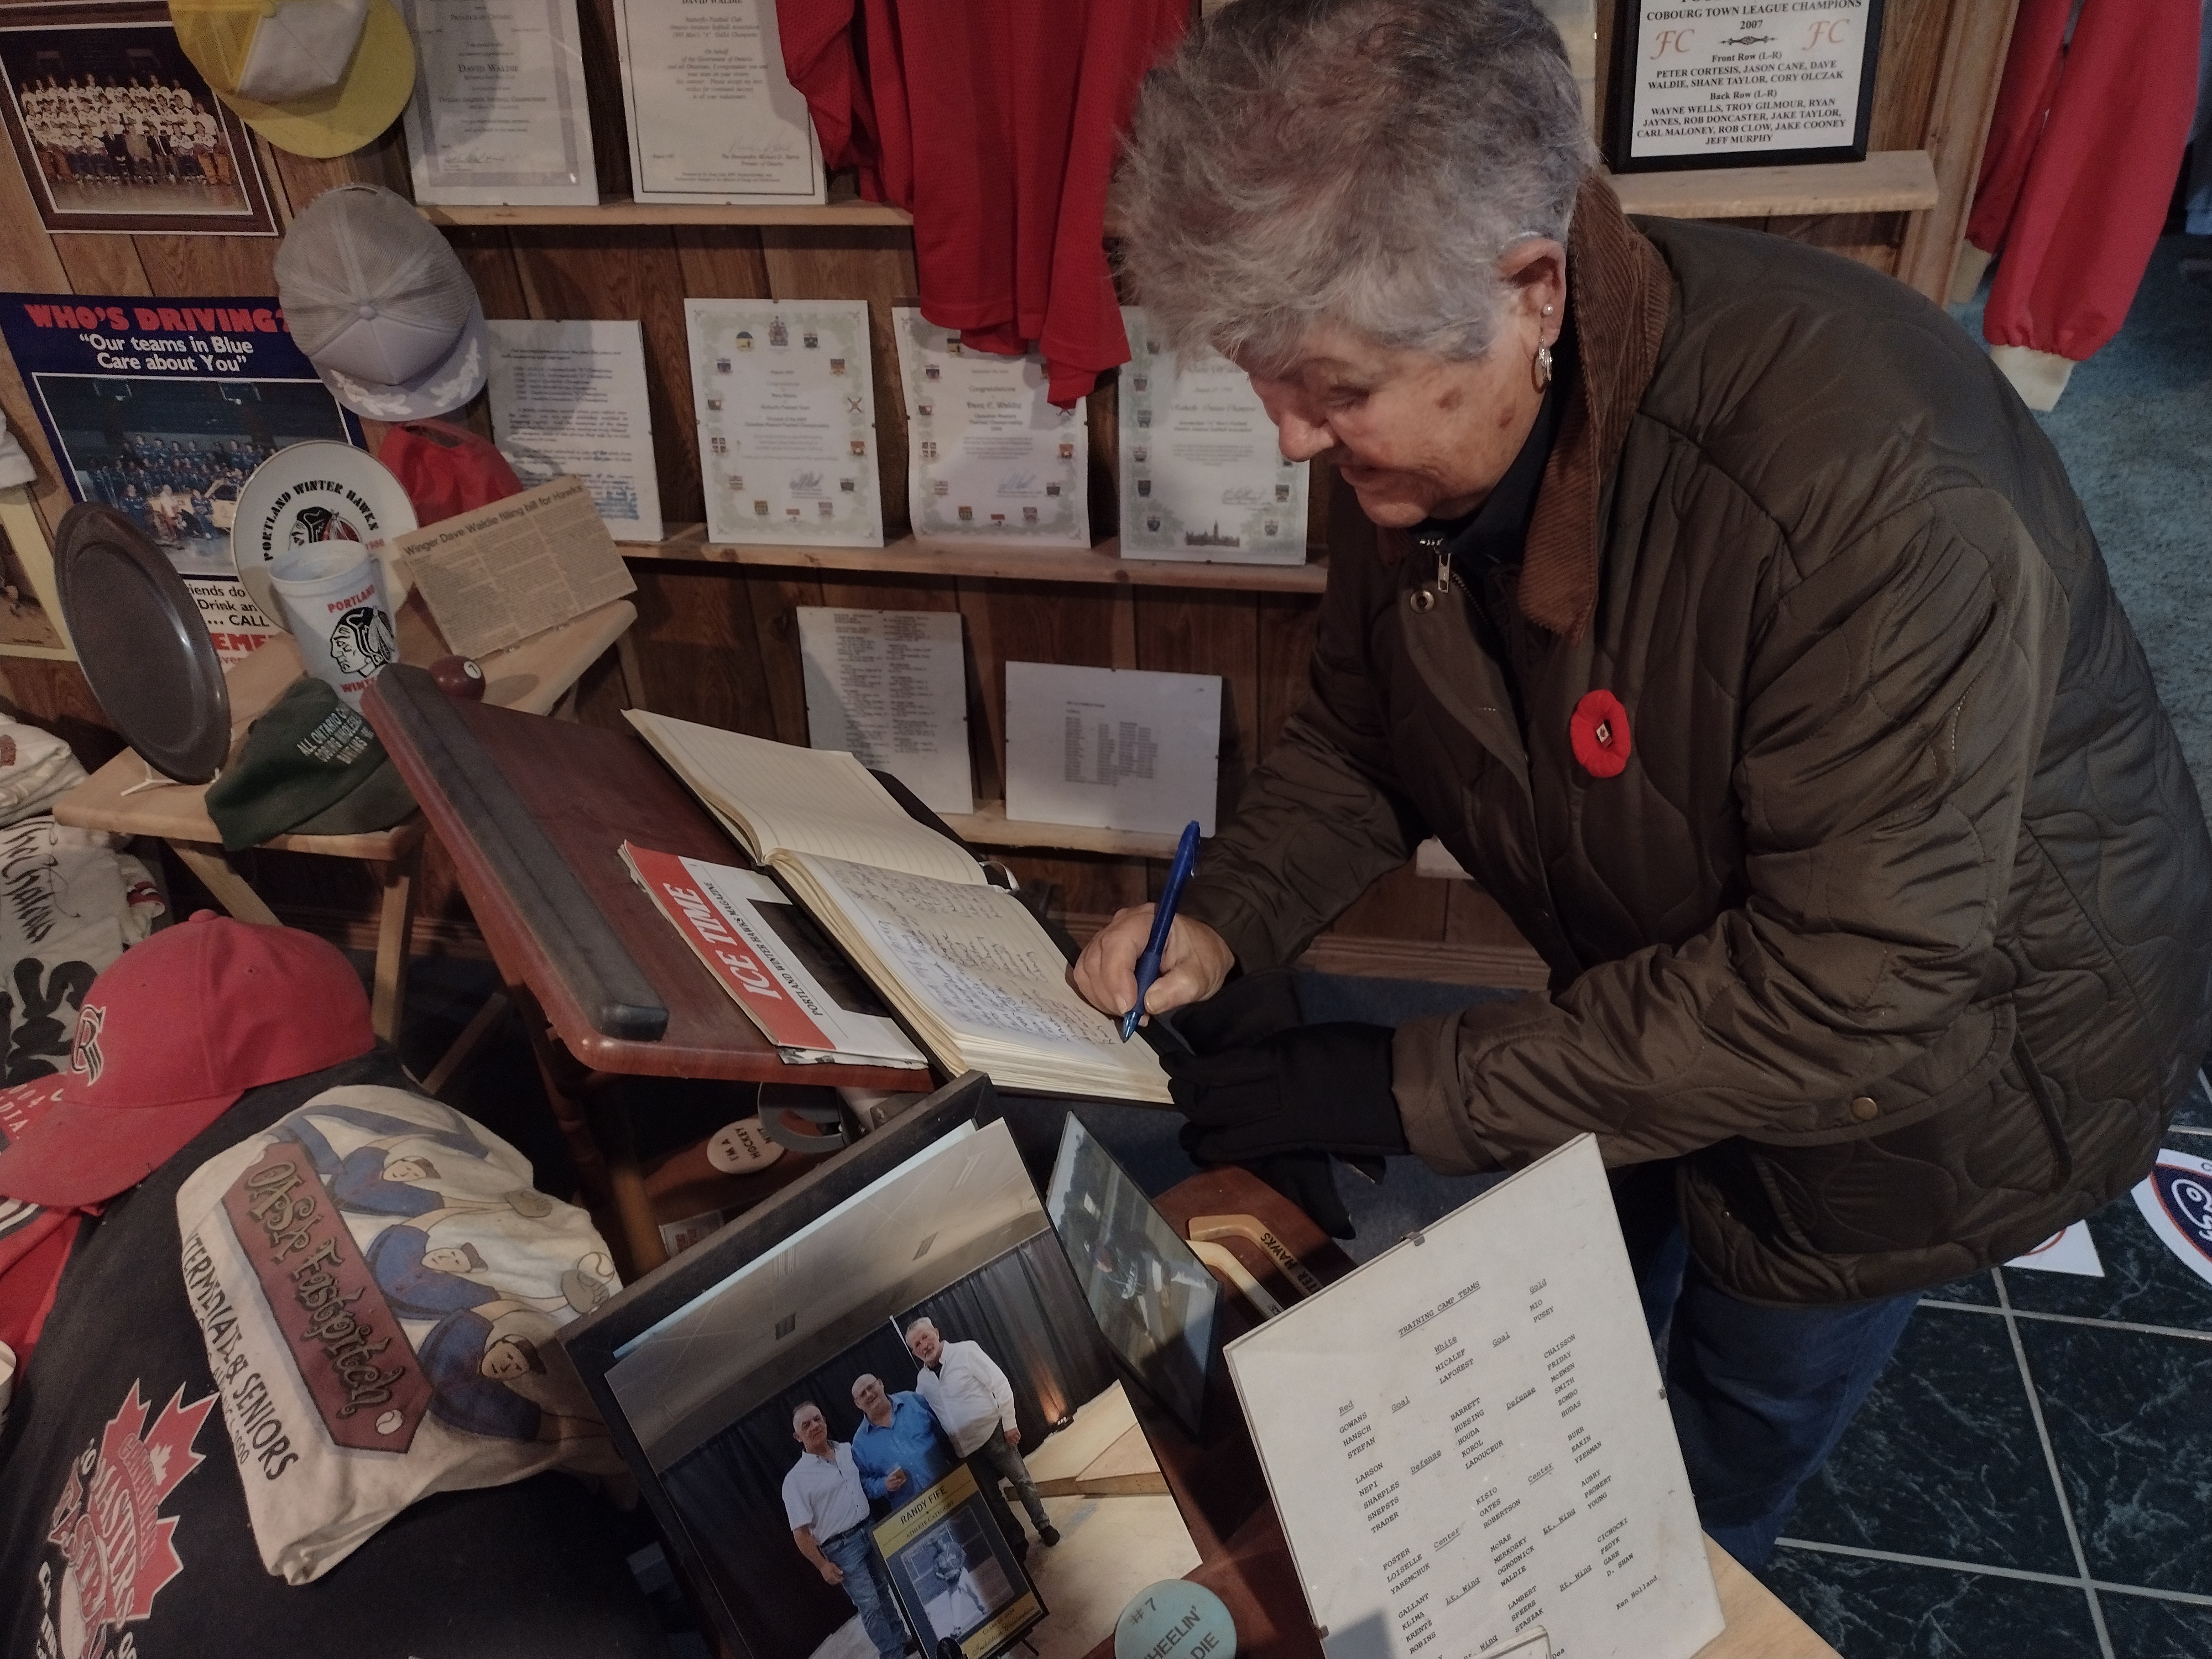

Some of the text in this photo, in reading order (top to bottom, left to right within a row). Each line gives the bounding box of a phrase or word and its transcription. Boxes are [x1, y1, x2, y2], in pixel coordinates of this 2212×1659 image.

[1647, 0, 1862, 21] COBOURG TOWN LEAGUE CHAMPIONS
[1740, 19, 1763, 30] 2007
[1712, 54, 1735, 62] Front
[1738, 53, 1756, 61] Row
[1648, 71, 1844, 89] WALDIE, SHANE TAYLOR, CORY OLCZAK
[1657, 69, 1688, 79] PETER
[1743, 63, 1775, 74] JASON
[1777, 61, 1808, 71] CANE,
[1810, 60, 1837, 69] DAVE
[1710, 91, 1730, 101] Back
[1733, 90, 1751, 98] Row
[1651, 98, 1835, 115] WAYNE WELLS, TROY GILMOUR, RYAN
[1643, 108, 1841, 127] JAYNES, ROB DONCASTER, JAKE TAYLOR,
[1636, 128, 1663, 138] CARL
[1718, 124, 1739, 134] ROB
[1741, 123, 1773, 133] CLOW,
[1775, 121, 1801, 131] JAKE
[1803, 119, 1846, 130] COONEY
[1705, 134, 1773, 145] JEFF MURPHY
[131, 335, 187, 352] teams
[190, 335, 208, 353] in
[210, 336, 254, 354] Blue
[96, 352, 142, 370] Care
[147, 353, 198, 371] about
[262, 479, 379, 561] PORTLAND WINTER HAWKS
[403, 539, 439, 556] Winger
[439, 528, 466, 544] Dave
[465, 515, 499, 533] Waldie
[523, 500, 539, 513] bill
[538, 494, 552, 506] for
[552, 484, 584, 501] Hawks
[196, 598, 259, 612] Drink an
[228, 614, 270, 627] CALL
[296, 738, 318, 757] ALL
[310, 712, 342, 745] ONTARIO
[663, 882, 782, 1000] ICE TIME
[703, 880, 823, 1016] PORTLAND WINTER HAWKS MAGAZINE
[721, 1138, 731, 1146] A
[735, 1127, 761, 1160] HOCKEY
[1260, 1232, 1298, 1270] HAWKS
[1298, 1269, 1318, 1292] TER
[1530, 1279, 1547, 1295] Gold
[1398, 1281, 1481, 1338] TRAINING CAMP TEAMS
[1530, 1300, 1542, 1311] MIO
[1533, 1306, 1553, 1323] PUSEY
[1434, 1337, 1457, 1355] White
[1493, 1332, 1510, 1347] Goal
[1544, 1334, 1575, 1358] CHAISSON
[226, 1353, 249, 1385] &
[1435, 1349, 1465, 1372] MICALEF
[1439, 1358, 1473, 1384] LAFOREST
[1547, 1352, 1571, 1370] FRIDAY
[1551, 1363, 1574, 1383] McEWEN
[1554, 1377, 1574, 1394] SMITH
[1339, 1400, 1354, 1416] Red
[1392, 1396, 1410, 1413] Goal
[1506, 1387, 1536, 1410] Defense
[1558, 1389, 1578, 1406] ZOMBO
[1451, 1397, 1480, 1421] BARRETT
[1561, 1401, 1580, 1418] HUDAS
[233, 1372, 299, 1481] SENIORS
[1339, 1412, 1367, 1433] GOWANS
[1454, 1410, 1484, 1433] HUESING
[1343, 1425, 1371, 1446] HANSCH
[1458, 1428, 1480, 1446] HOUDA
[1568, 1427, 1584, 1441] BURR
[1572, 1435, 1591, 1453] EAKIN
[1348, 1437, 1375, 1459] STEFAN
[1462, 1440, 1483, 1457] KOROL
[1465, 1440, 1503, 1469] LADOUCEUR
[1574, 1441, 1601, 1463] YZERMAN
[1355, 1462, 1383, 1484] LARSON
[1411, 1451, 1441, 1475] Defense
[1528, 1463, 1553, 1485] Center
[1582, 1469, 1600, 1487] AUBRY
[1359, 1481, 1378, 1496] NEPI
[1364, 1481, 1399, 1509] SHARPLES
[1476, 1487, 1497, 1505] KISIO
[1584, 1475, 1611, 1498] PROBERT
[900, 1486, 947, 1525] RANDY FIFE
[1368, 1496, 1399, 1521] SNEPSTS
[1480, 1499, 1501, 1516] OATES
[1588, 1492, 1607, 1509] YOUNG
[1371, 1512, 1399, 1533] TRADER
[1484, 1499, 1520, 1528] ROBERTSON
[1558, 1507, 1576, 1523] Wing
[1434, 1528, 1460, 1552] Center
[1598, 1518, 1627, 1542] CICHOCKI
[90, 1457, 138, 1632] MASTERS
[1490, 1534, 1511, 1552] McRAE
[1494, 1537, 1526, 1564] MERKOSKY
[1601, 1537, 1620, 1554] FEDYK
[1383, 1548, 1410, 1571] FOSTER
[1387, 1554, 1422, 1583] LOISELLE
[1498, 1546, 1534, 1575] OGRODNICK
[1604, 1551, 1619, 1565] GARE
[1618, 1553, 1634, 1568] SHAW
[1391, 1563, 1430, 1594] YAREMCHUK
[1501, 1566, 1526, 1587] WALDIE
[1559, 1564, 1593, 1592] Rt. Wing
[1445, 1577, 1481, 1606] Lt. Wing
[1508, 1585, 1536, 1610] LAMBERT
[1616, 1574, 1658, 1610] Ken Holland
[1399, 1593, 1428, 1618] GALLANT
[1511, 1600, 1536, 1621] SPEERS
[1402, 1612, 1425, 1630] KLIMA
[1515, 1608, 1543, 1632] STASZAK
[1406, 1620, 1432, 1642] KRENTZ
[1190, 1631, 1220, 1659] DIE
[1410, 1632, 1436, 1654] ROBINS
[1479, 1635, 1499, 1651] Wing
